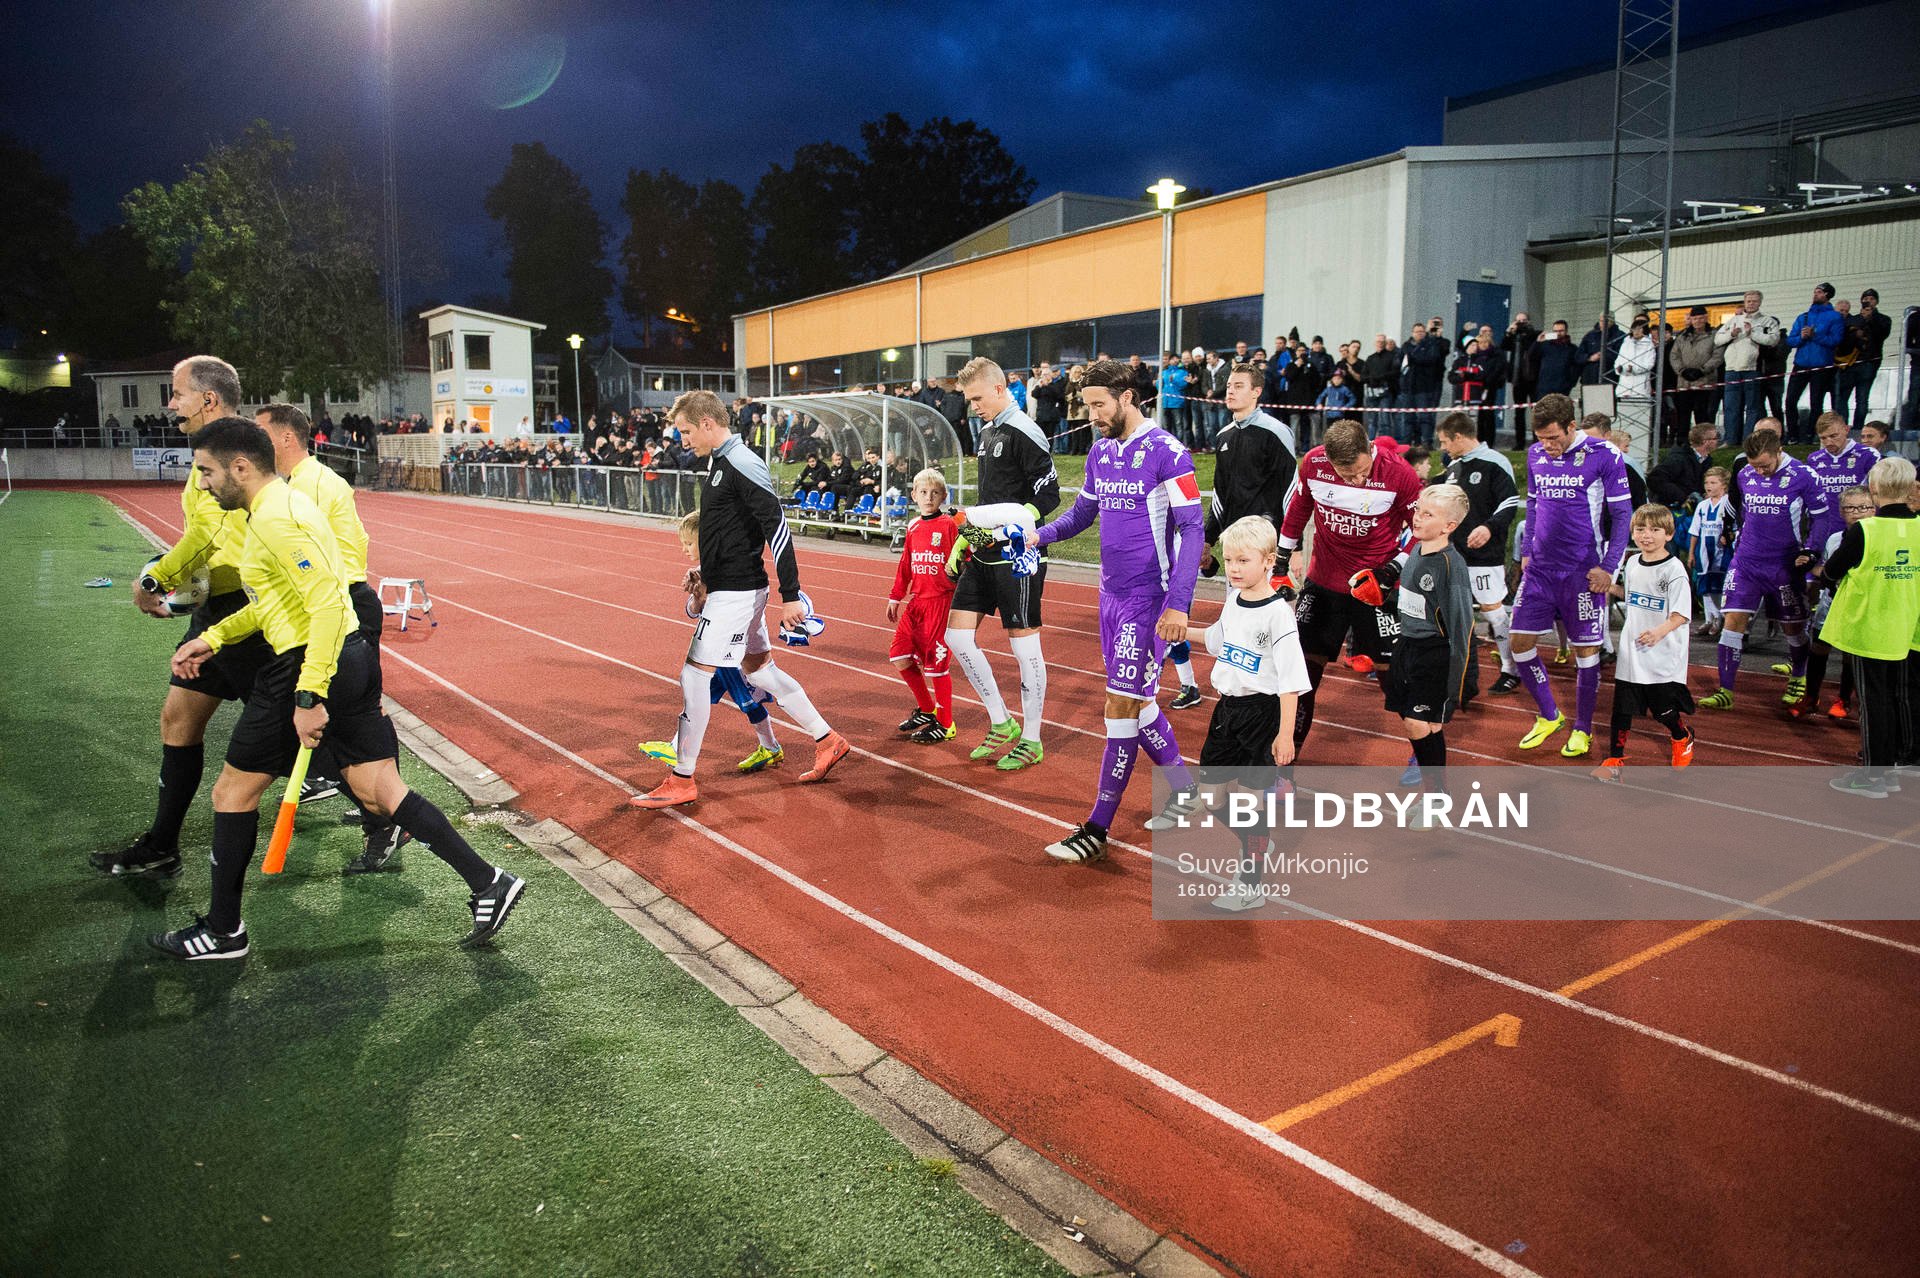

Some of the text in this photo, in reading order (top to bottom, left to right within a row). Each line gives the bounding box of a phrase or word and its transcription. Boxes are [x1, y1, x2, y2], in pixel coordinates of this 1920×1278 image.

[1095, 477, 1145, 495] Prioritet
[1534, 474, 1584, 487] Prioritet
[1541, 485, 1576, 498] Finans
[1098, 493, 1136, 510] Finans
[1744, 493, 1788, 505] Prioritet
[1317, 504, 1378, 528] Prioritet
[1748, 504, 1780, 515] Finans
[1324, 521, 1368, 537] Finans
[911, 550, 945, 564] ioritet
[1578, 592, 1591, 602] SE
[1578, 601, 1594, 612] RN
[1377, 615, 1395, 627] RN
[1578, 609, 1598, 621] EKE
[1121, 623, 1137, 635] SE
[1379, 622, 1401, 637] EKE
[1119, 634, 1137, 648] RN
[1115, 645, 1140, 661] EKE
[1116, 663, 1138, 680] 30
[1142, 728, 1168, 751] SKF
[1111, 745, 1129, 780] SKF
